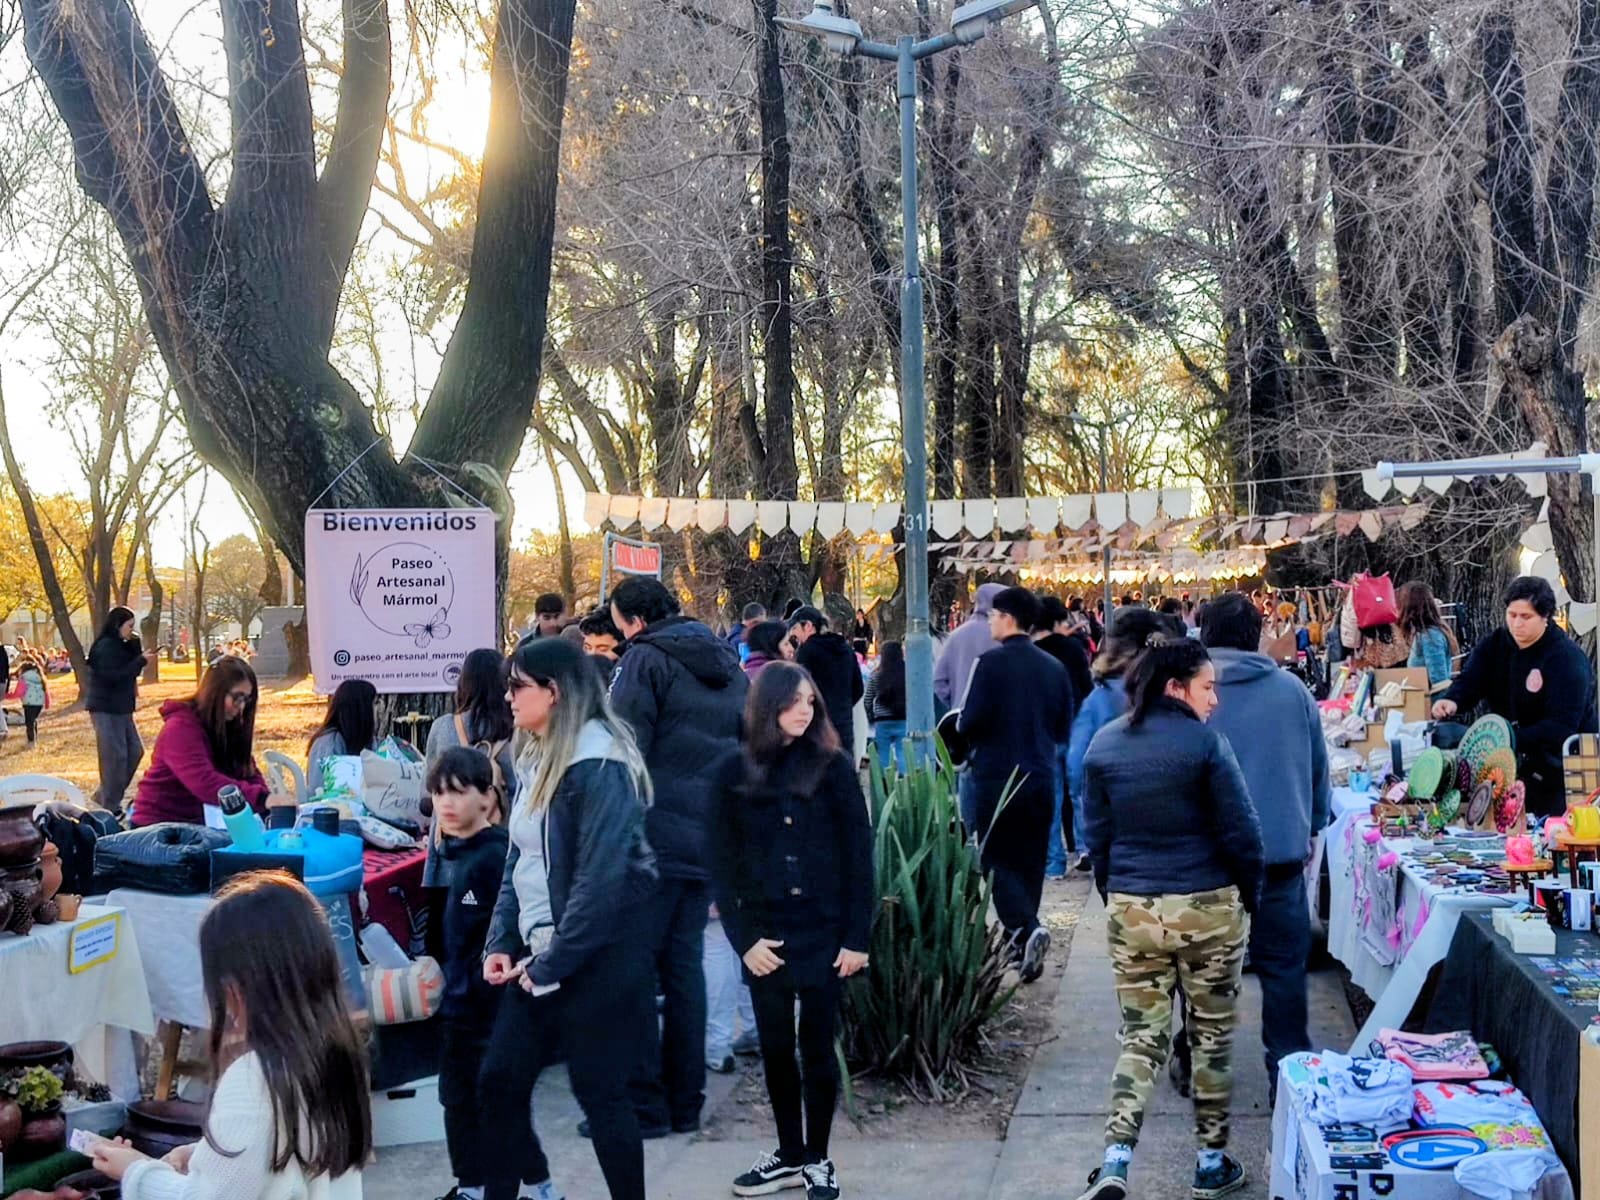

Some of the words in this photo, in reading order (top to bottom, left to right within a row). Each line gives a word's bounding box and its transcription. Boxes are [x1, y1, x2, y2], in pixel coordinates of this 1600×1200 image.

[322, 511, 477, 531] Bienvenidos
[906, 513, 924, 532] 31
[392, 557, 433, 569] Paseo
[376, 575, 445, 588] Artesanal
[383, 593, 438, 606] Mármol
[330, 673, 341, 681] Un
[343, 673, 380, 681] encuentro
[396, 671, 403, 679] el
[421, 670, 438, 678] local
